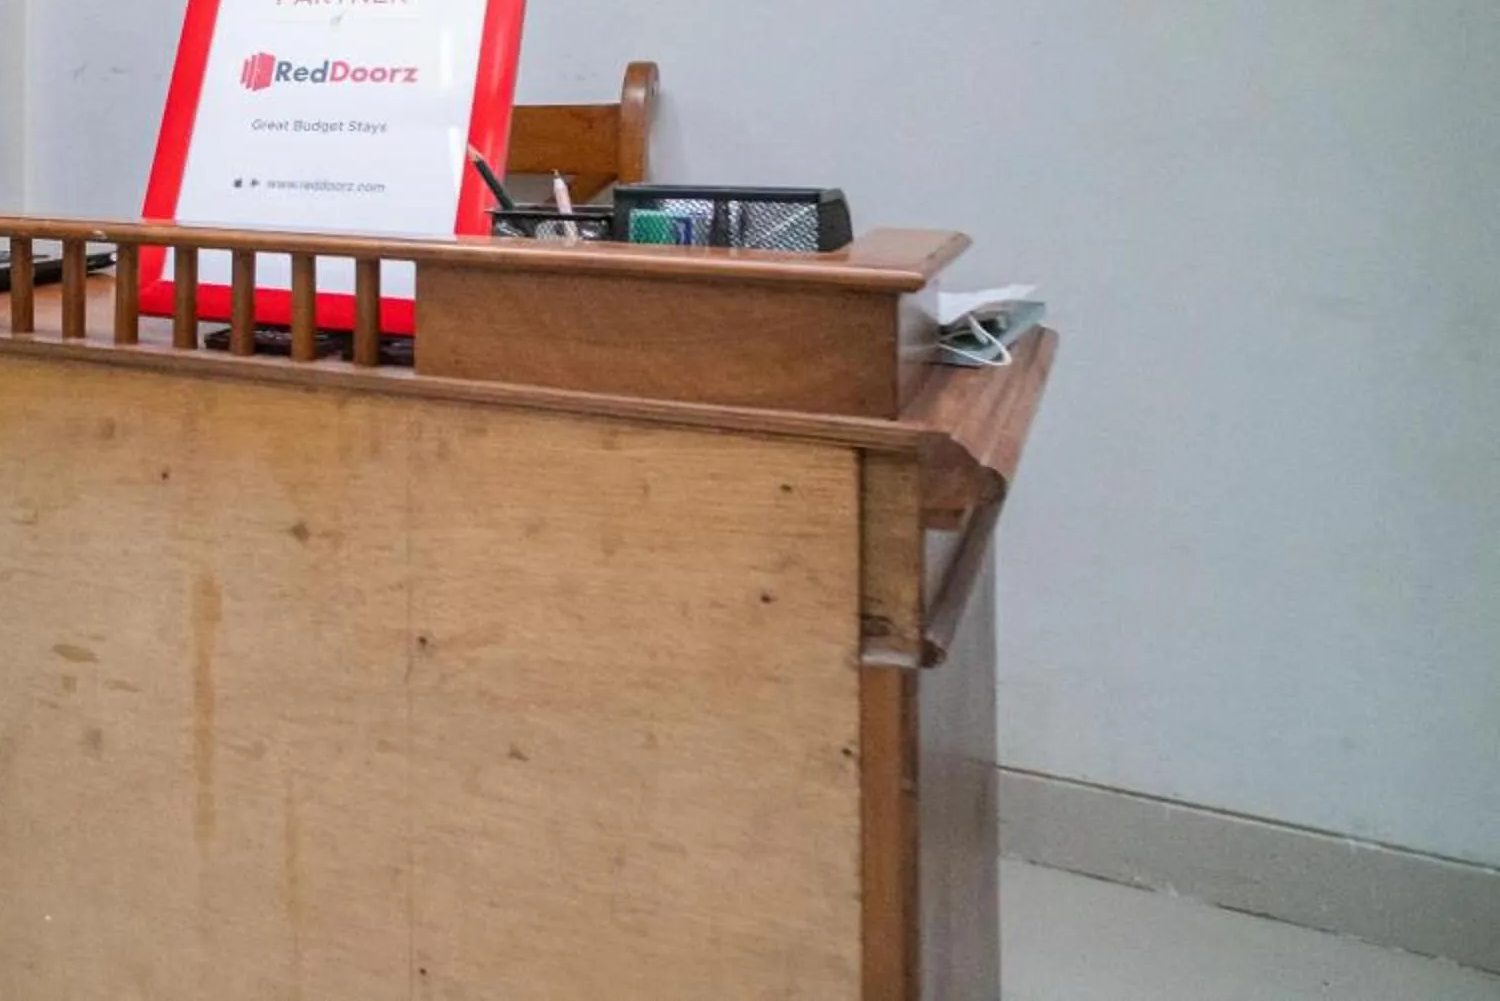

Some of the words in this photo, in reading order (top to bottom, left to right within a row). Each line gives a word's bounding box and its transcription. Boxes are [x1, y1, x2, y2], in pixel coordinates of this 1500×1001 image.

[274, 60, 419, 83] RedDoorz
[251, 119, 290, 132] Great
[293, 119, 344, 134] Budget
[347, 120, 388, 135] Stays
